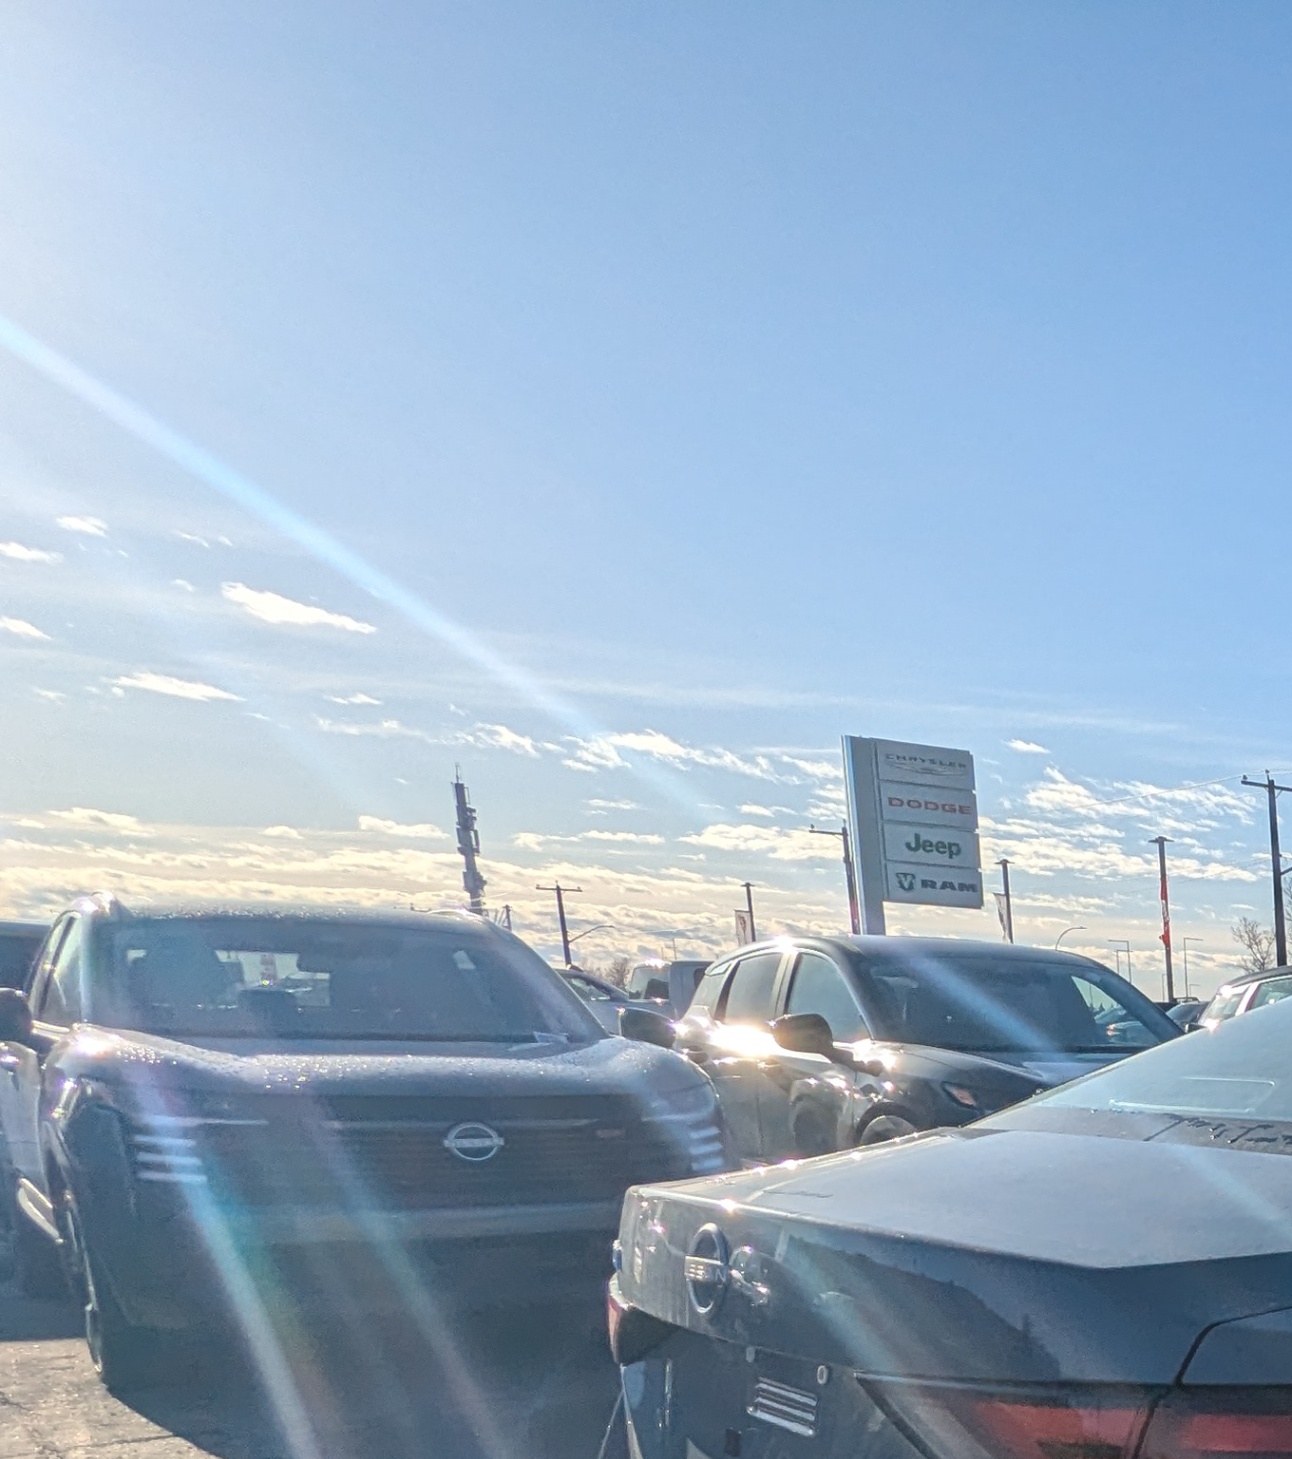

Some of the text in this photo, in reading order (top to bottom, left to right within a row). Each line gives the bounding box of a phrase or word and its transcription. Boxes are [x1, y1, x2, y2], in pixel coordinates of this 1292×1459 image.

[885, 753, 967, 768] CHRYSLER
[888, 797, 972, 815] DODGE
[905, 833, 962, 859] Jeep
[921, 879, 978, 893] RAM
